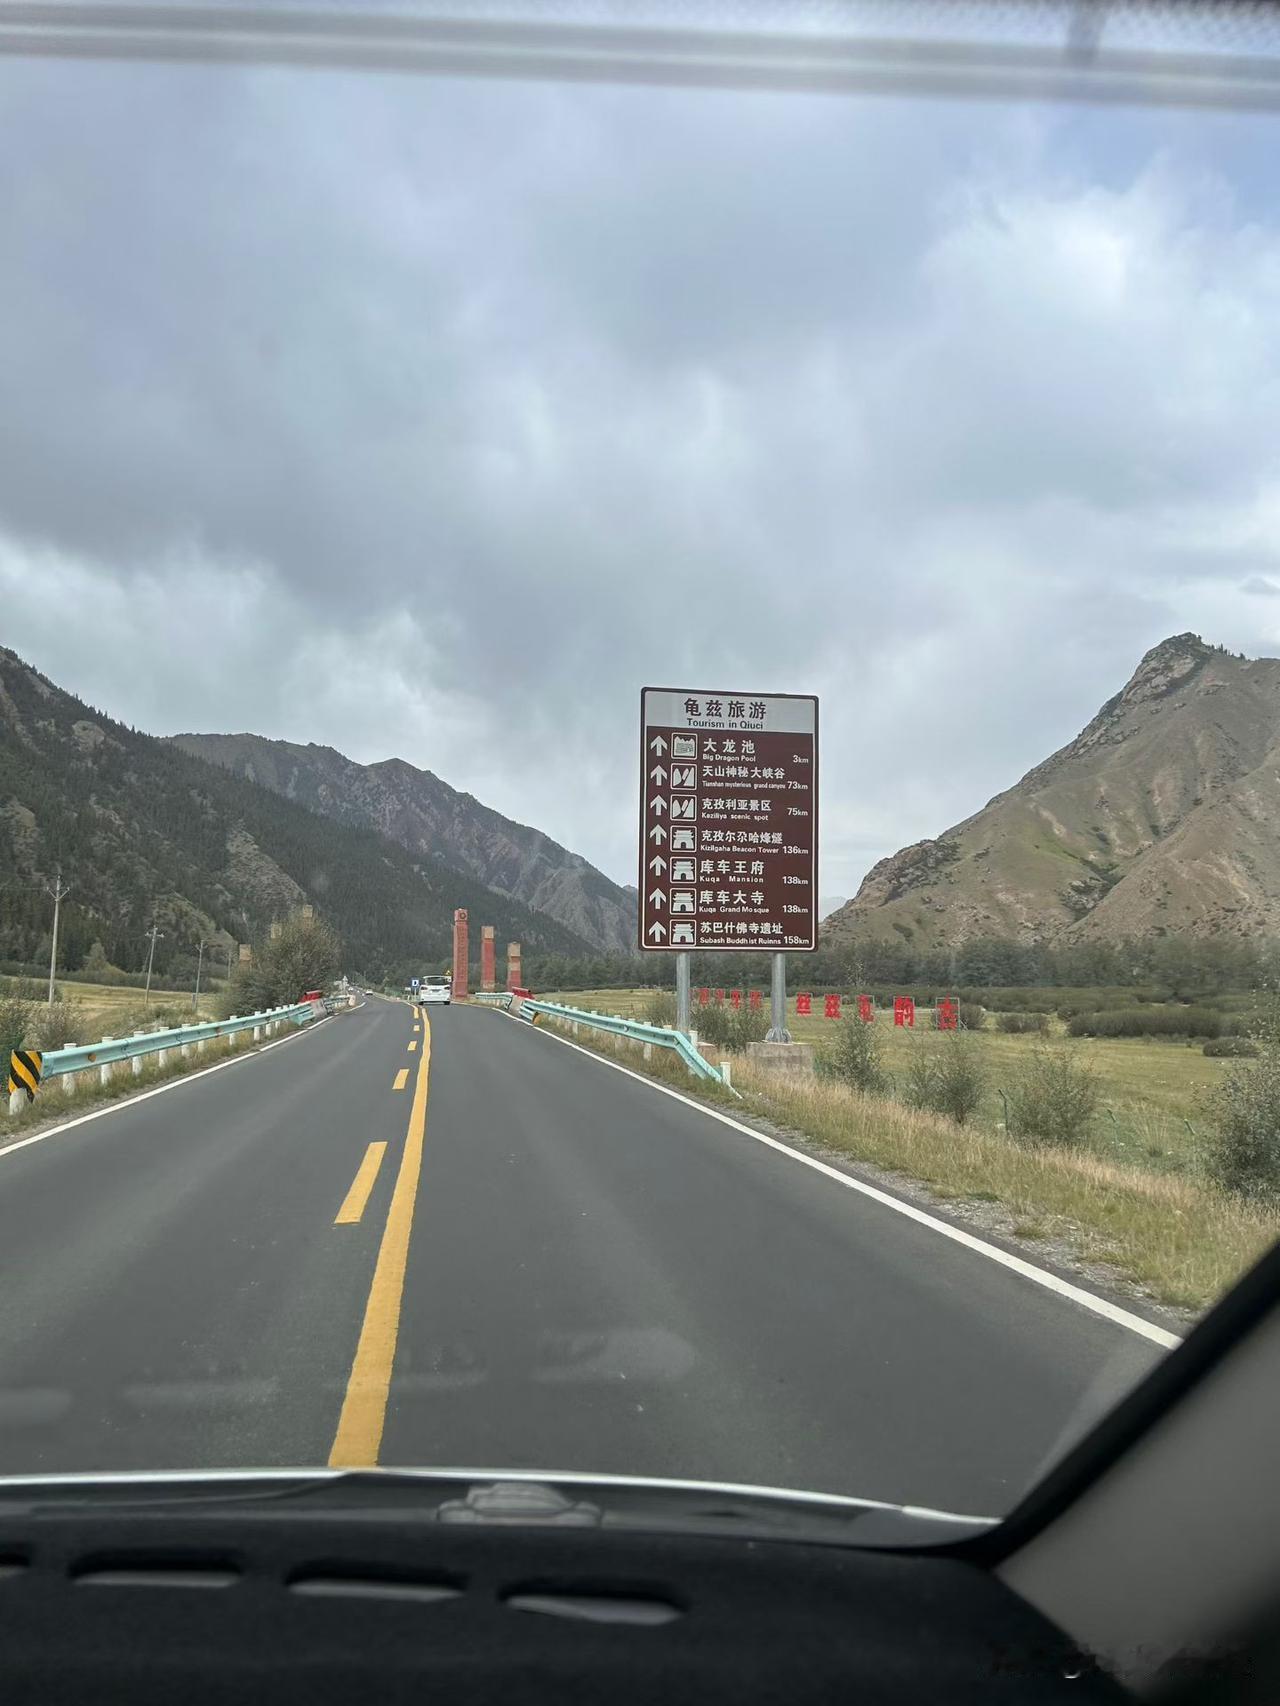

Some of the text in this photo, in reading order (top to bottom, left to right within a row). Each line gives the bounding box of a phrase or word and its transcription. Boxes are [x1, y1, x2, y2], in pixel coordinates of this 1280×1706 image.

[684, 698, 766, 719] 龟兹旅游
[687, 718, 763, 729] Tourism in Qiuci
[703, 738, 755, 754] 大龙池
[793, 755, 808, 763] 3km
[702, 766, 785, 779] 天山神秘大峡谷
[788, 781, 808, 790] 73km
[702, 798, 772, 811] 克孜利亚景区
[787, 808, 808, 816] 75km
[702, 830, 782, 844] 克孜尔尕哈烽燧
[783, 846, 808, 854] 136km
[700, 860, 764, 874] 库车王府
[782, 876, 808, 884] 138km
[700, 891, 765, 905] 库车大寺
[782, 905, 808, 913] 138km
[700, 922, 783, 934] 苏巴什佛寺遗址
[784, 936, 809, 944] 158km
